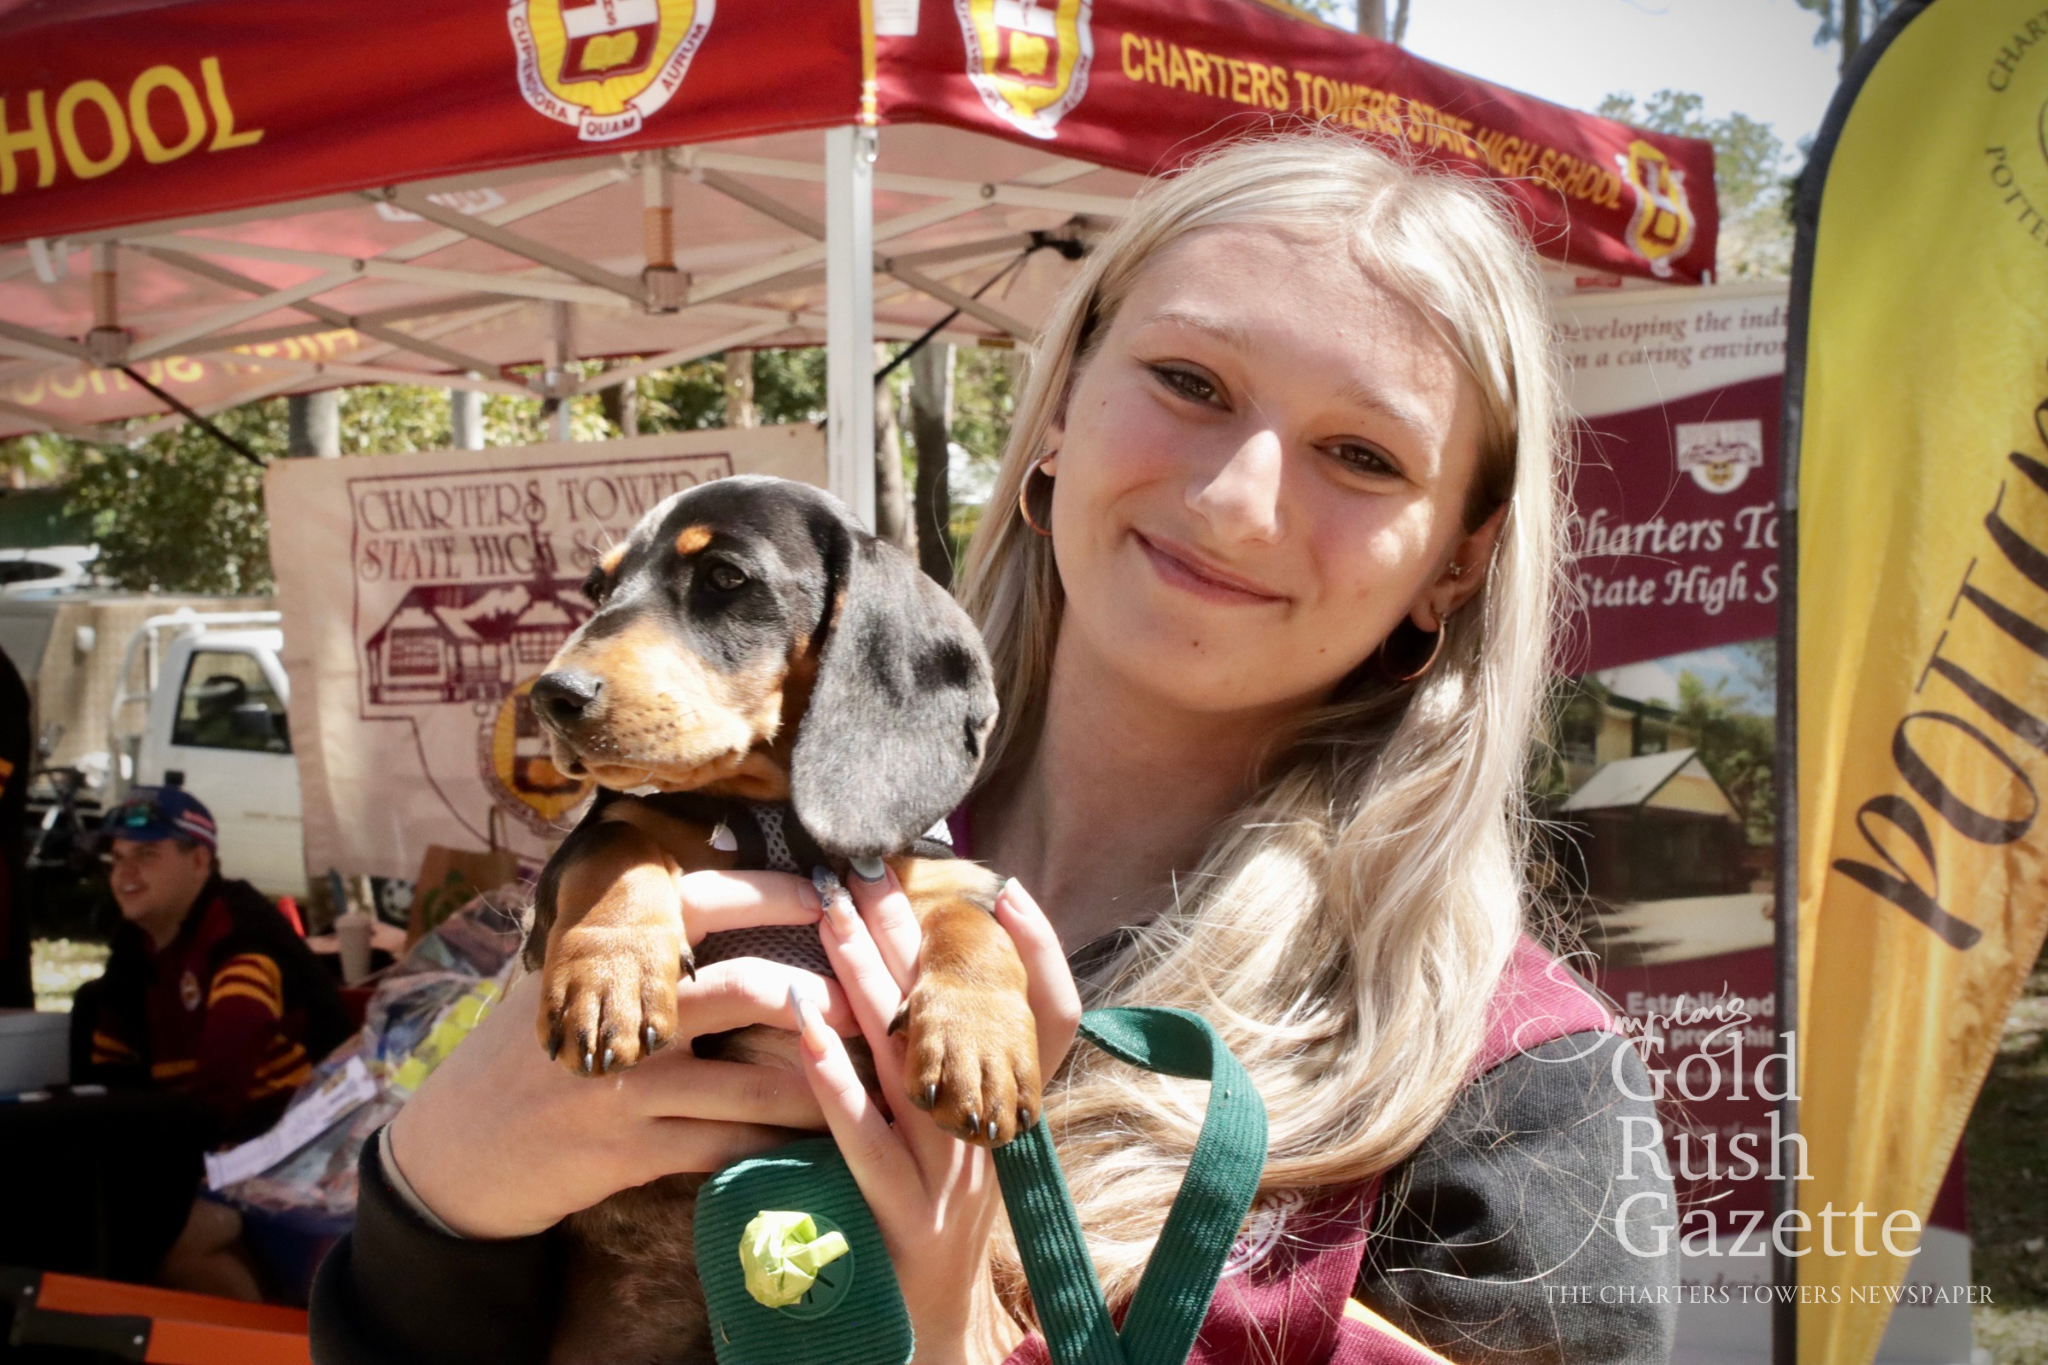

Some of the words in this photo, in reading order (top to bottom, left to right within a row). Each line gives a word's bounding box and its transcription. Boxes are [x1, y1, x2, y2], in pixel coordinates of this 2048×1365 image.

[664, 23, 706, 93] AURUM
[586, 117, 635, 136] QUAM
[1120, 32, 1290, 112] CHARTERS
[1293, 70, 1402, 136] TOWERS
[1406, 98, 1477, 159] STATE
[1474, 126, 1537, 178] HIGH
[1532, 148, 1620, 209] SCHOOL
[1984, 146, 2048, 248] POTTE
[1695, 311, 1732, 334] the
[1596, 352, 1608, 367] a
[1617, 344, 1692, 370] caring
[359, 479, 548, 533] CHARTERS
[359, 534, 466, 583] STATE
[1569, 572, 1656, 611] State
[1663, 561, 1748, 616] High
